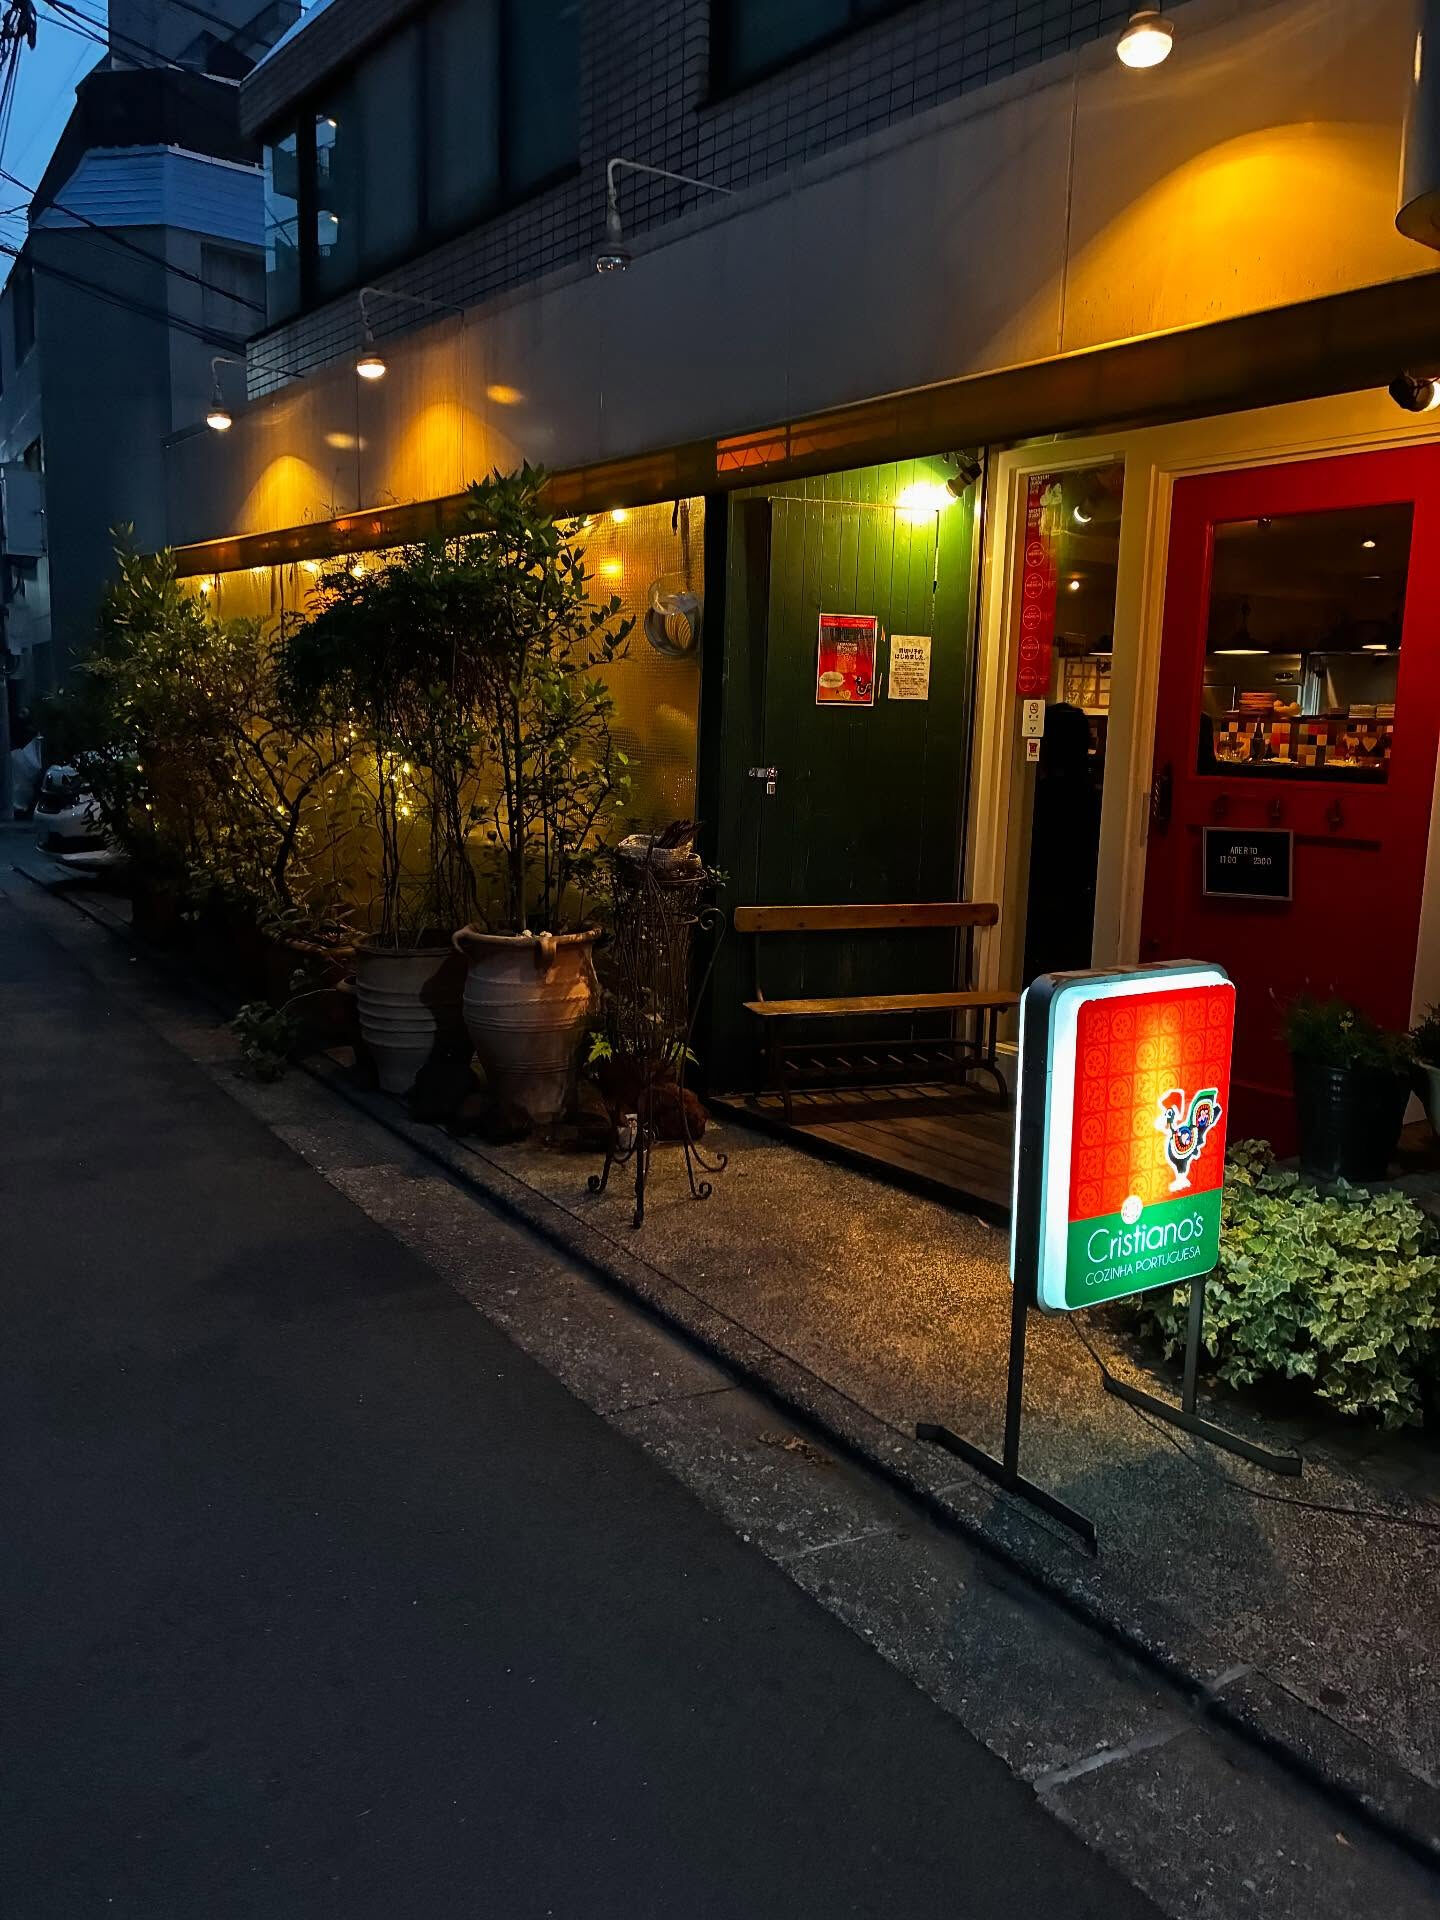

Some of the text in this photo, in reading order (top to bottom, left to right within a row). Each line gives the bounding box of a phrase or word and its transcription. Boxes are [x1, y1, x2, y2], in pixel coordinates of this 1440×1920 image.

[1087, 1212, 1204, 1263] Cristiano's
[1085, 1246, 1201, 1286] COZINHA PORTUGUESA
